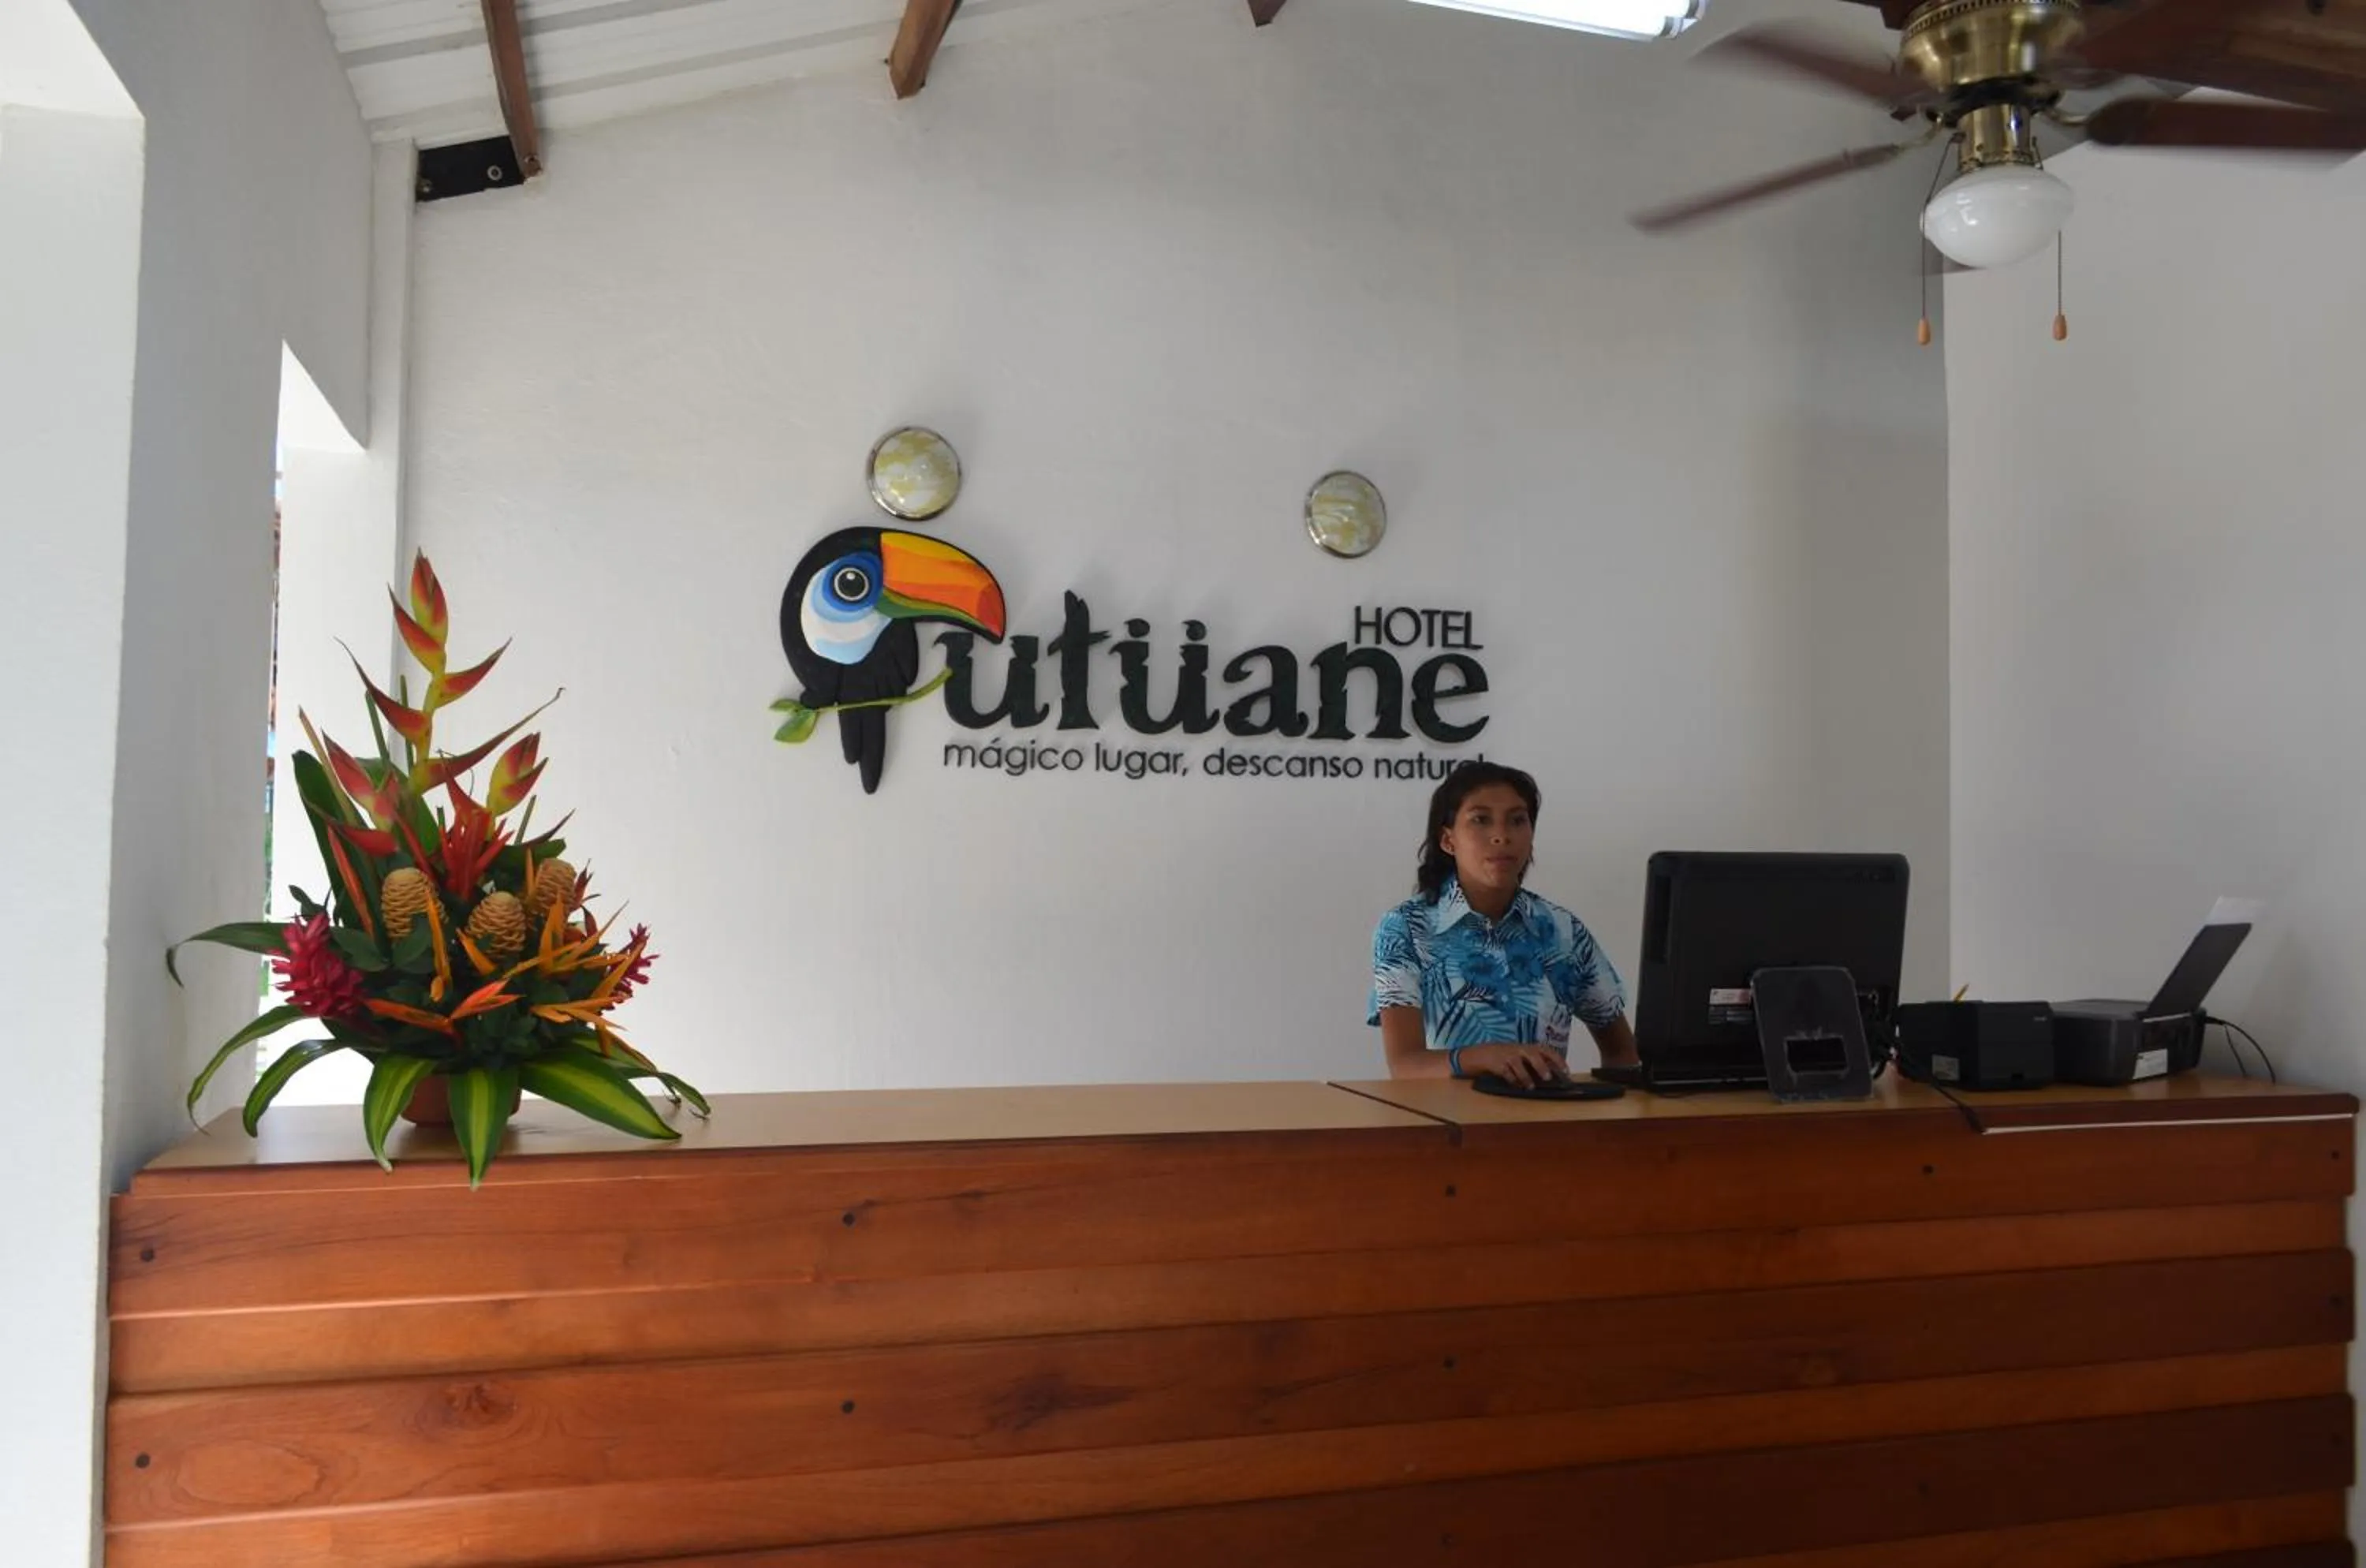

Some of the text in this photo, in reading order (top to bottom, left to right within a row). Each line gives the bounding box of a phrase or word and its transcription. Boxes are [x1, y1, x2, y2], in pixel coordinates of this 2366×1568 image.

[1354, 605, 1484, 650] HOTEL
[943, 737, 1484, 781] mágico lugar, descanso natur
